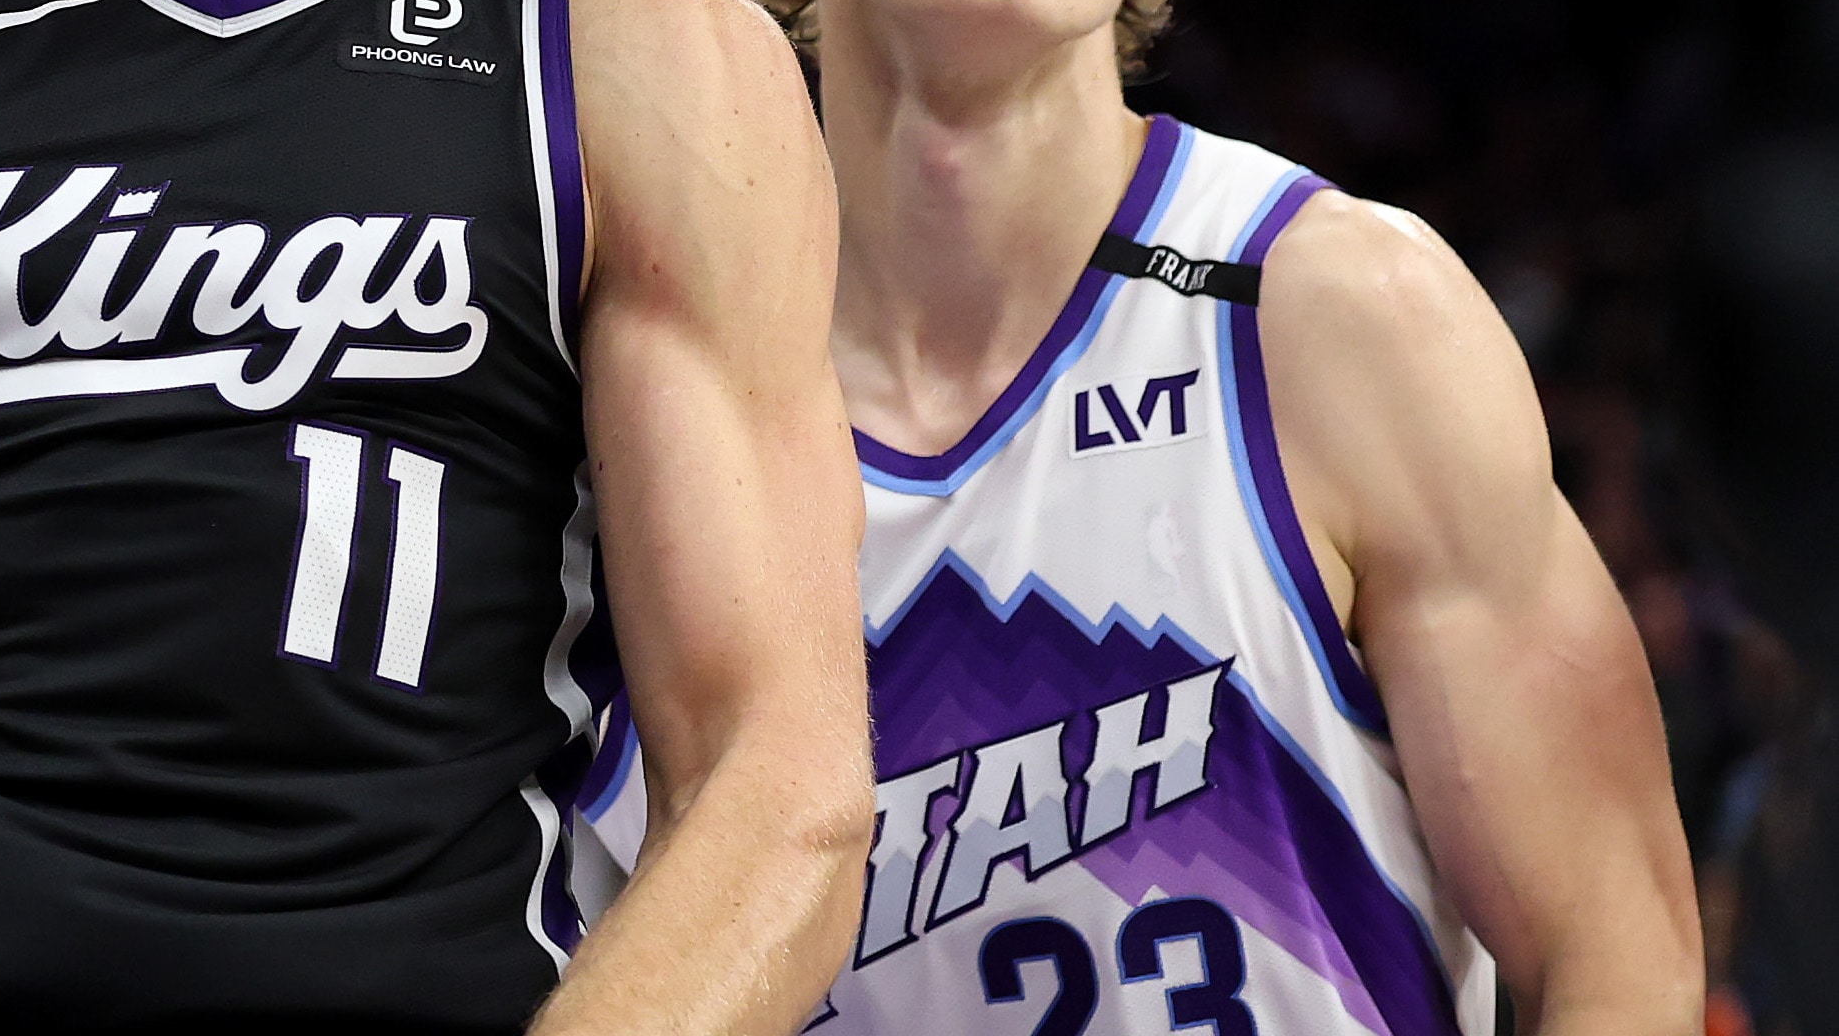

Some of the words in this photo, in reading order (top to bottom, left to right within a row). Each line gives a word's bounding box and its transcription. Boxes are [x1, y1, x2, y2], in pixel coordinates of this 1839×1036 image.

[351, 45, 444, 67] PHOONG
[448, 55, 496, 75] LAW
[1075, 368, 1201, 452] LVT
[277, 420, 449, 693] 11
[801, 656, 1236, 1036] TAH
[978, 896, 1259, 1036] 23
